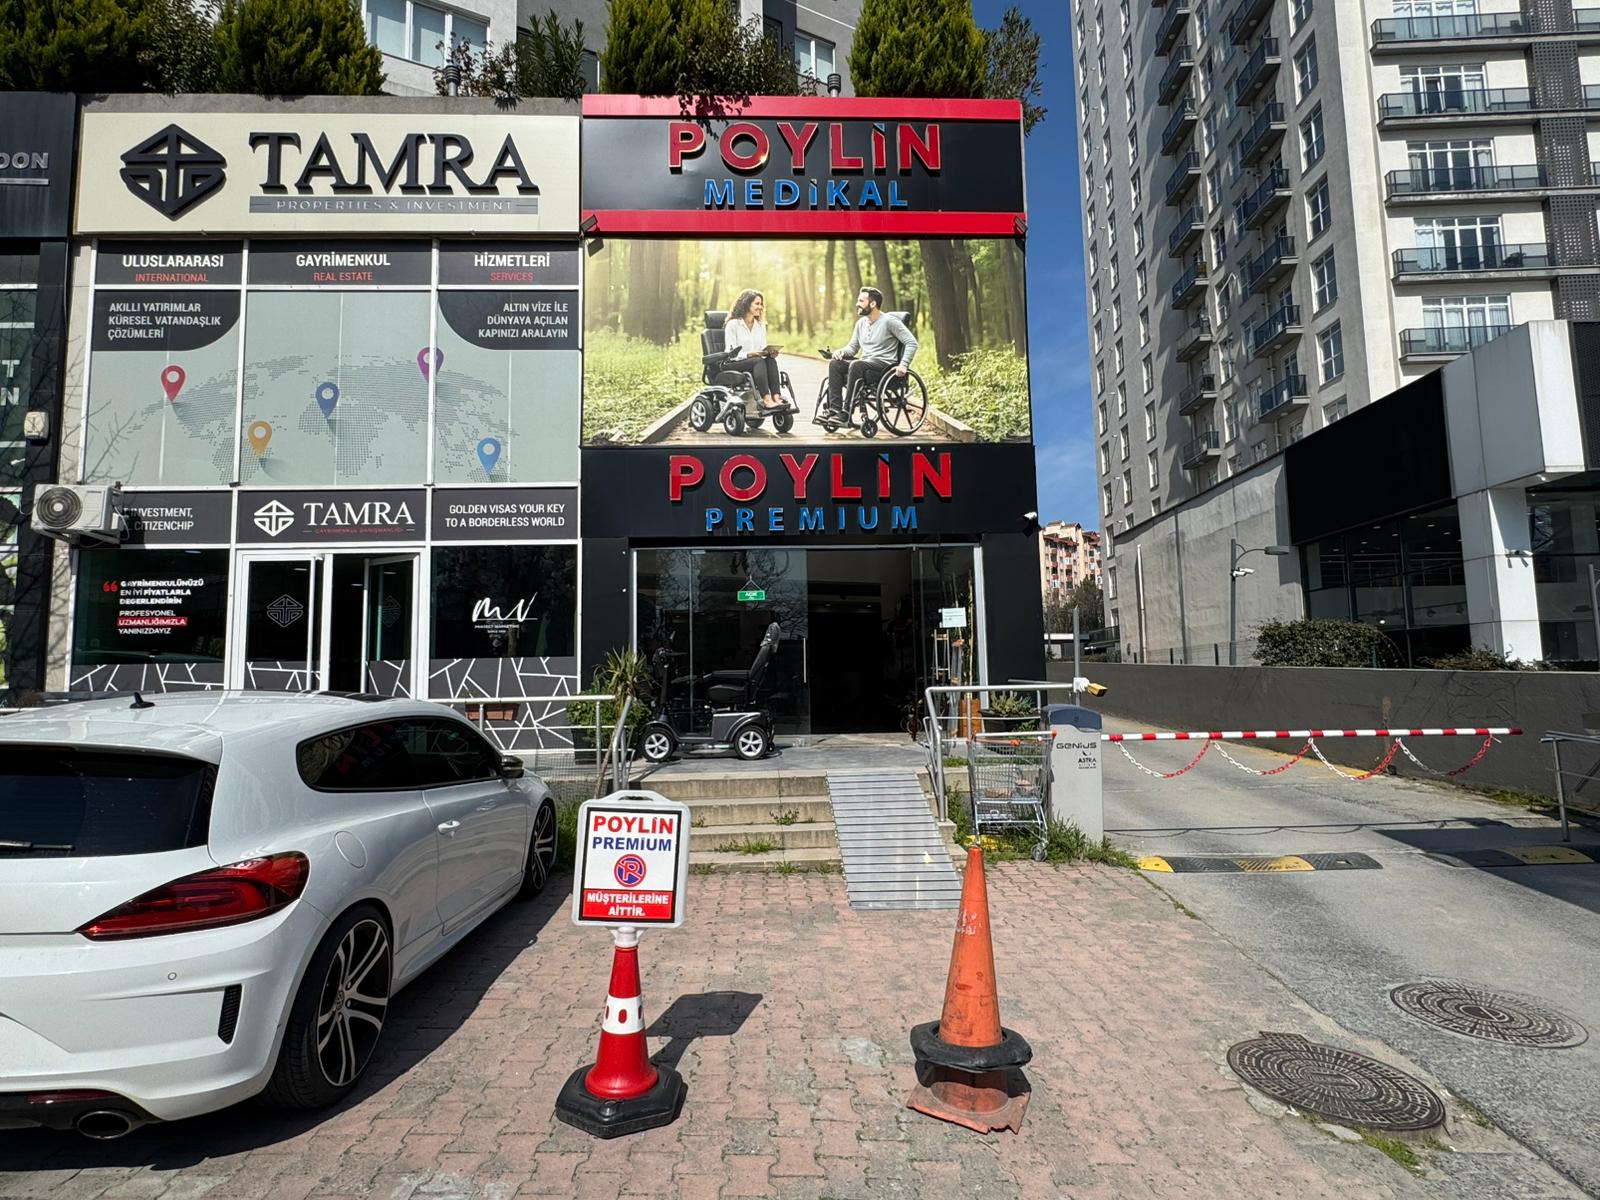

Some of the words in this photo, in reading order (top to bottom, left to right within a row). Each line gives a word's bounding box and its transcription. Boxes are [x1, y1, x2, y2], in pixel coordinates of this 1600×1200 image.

[249, 131, 540, 195] TAMRA
[704, 178, 908, 207] MEDİKAL
[277, 200, 381, 210] PROPERTIES
[389, 200, 398, 210] &
[407, 201, 511, 210] INVESTMENT
[122, 255, 224, 268] ULUSLARARASI
[296, 252, 391, 267] GAYRİMENKUL
[474, 252, 550, 267] HİZMETLERİ
[135, 273, 208, 282] INTERNATIONAL
[313, 272, 337, 281] REAL
[339, 272, 373, 281] ESTATE
[490, 272, 533, 281] SERVICES
[109, 303, 140, 312] AKILLI
[143, 303, 201, 312] YATIRIMLAR
[503, 303, 529, 312] ALTIN
[532, 302, 552, 312] VİZE
[554, 302, 568, 312] İLE
[108, 314, 152, 325] KÜRESEL
[155, 316, 221, 327] VATANDAŞLIK
[487, 313, 531, 325] DÜNYAYA
[534, 316, 568, 326] AÇILAN
[107, 328, 164, 340] ÇÖZÜMLERİ
[478, 329, 519, 338] KAPINIZI
[521, 329, 568, 338] ARALAYIN
[303, 501, 416, 526] TAMRA
[449, 505, 487, 514] GOLDEN
[489, 504, 517, 514] VISAS
[519, 504, 545, 513] YOUR
[547, 504, 565, 513] KEY
[445, 518, 458, 527] TO
[460, 518, 467, 527] A
[468, 517, 529, 527] BORDERLESS
[531, 517, 565, 526] WORLD
[705, 506, 918, 532] PREMIUM
[587, 891, 669, 905] MÜŞTERİLERİNE
[608, 904, 645, 917] AİTTİR.
